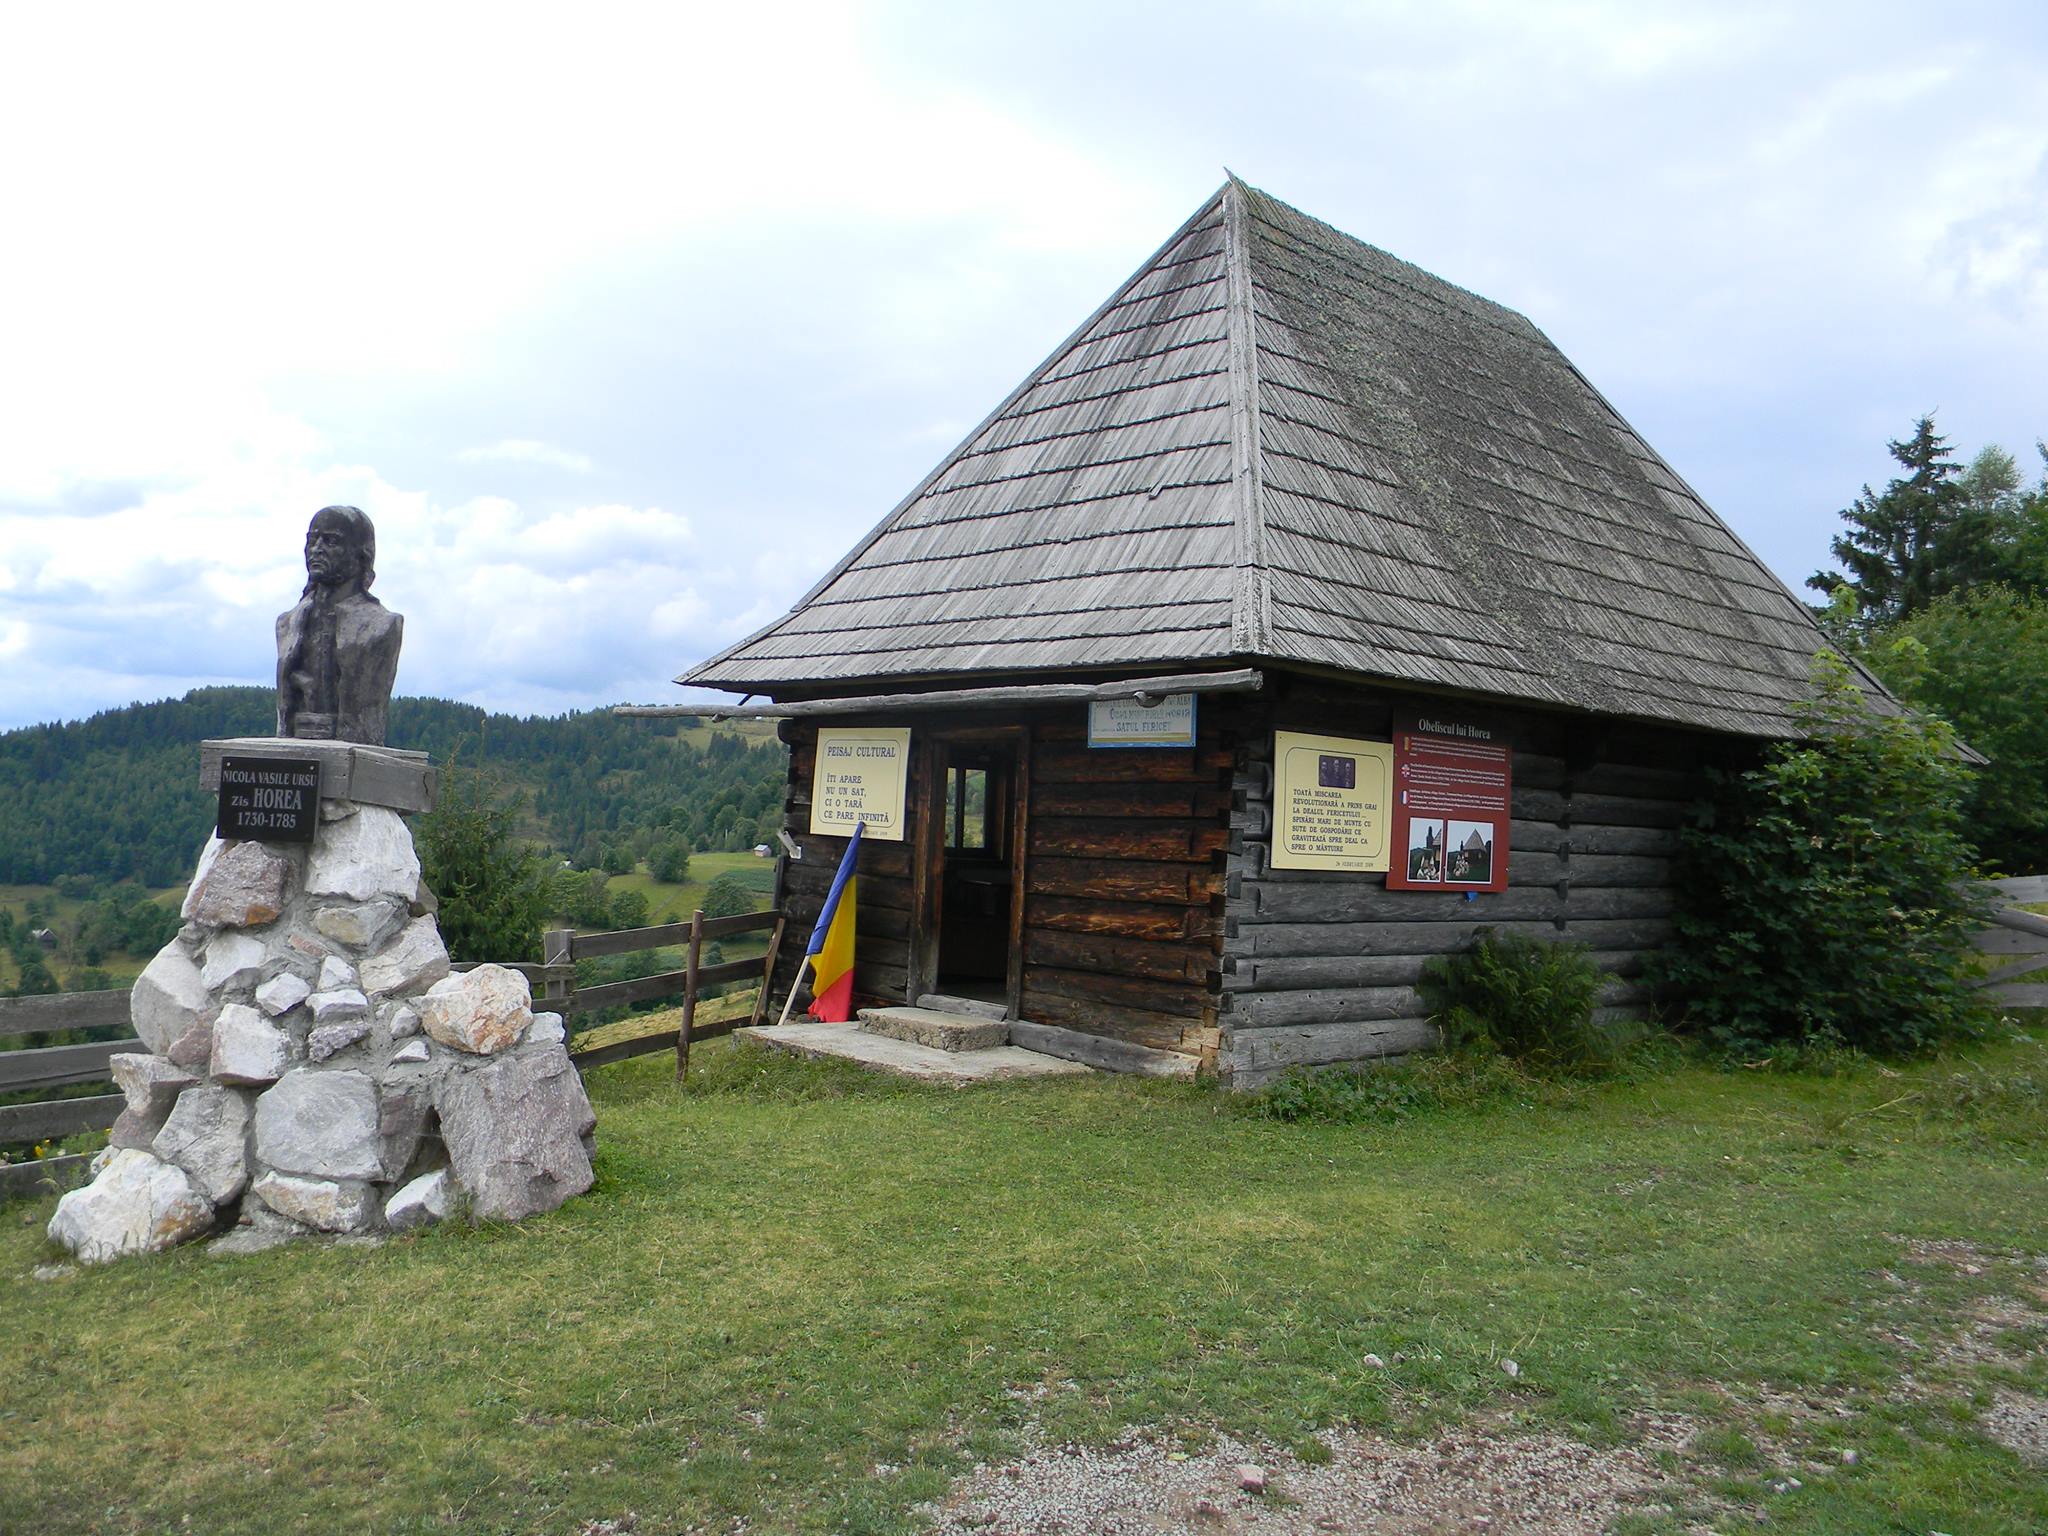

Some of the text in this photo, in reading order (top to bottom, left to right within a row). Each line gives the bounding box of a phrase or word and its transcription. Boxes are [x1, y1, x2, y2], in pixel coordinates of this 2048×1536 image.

[1115, 721, 1139, 732] SATUL
[1418, 718, 1491, 740] Obeliscul lui Horea
[827, 746, 896, 758] PEISAJ CULTURAL
[222, 770, 317, 786] NICOLA VASILE URSU
[839, 775, 862, 784] APARE
[825, 786, 867, 798] NU UN SAT,
[231, 788, 302, 810] Zis HOREA
[824, 798, 833, 807] CI
[835, 798, 841, 807] O
[1302, 807, 1324, 815] DEALUL
[1347, 801, 1363, 809] PRINS
[1364, 803, 1377, 811] GRAI
[237, 811, 296, 829] 1730-1785
[823, 810, 834, 819] CE
[836, 810, 855, 820] PARE
[1316, 817, 1332, 825] MARI
[1333, 818, 1342, 826] DE
[1343, 819, 1362, 827] MUNTE
[1363, 820, 1371, 828] CE
[1292, 825, 1307, 833] SUTE
[1328, 836, 1343, 844] SPRE
[1291, 843, 1307, 851] SPRE
